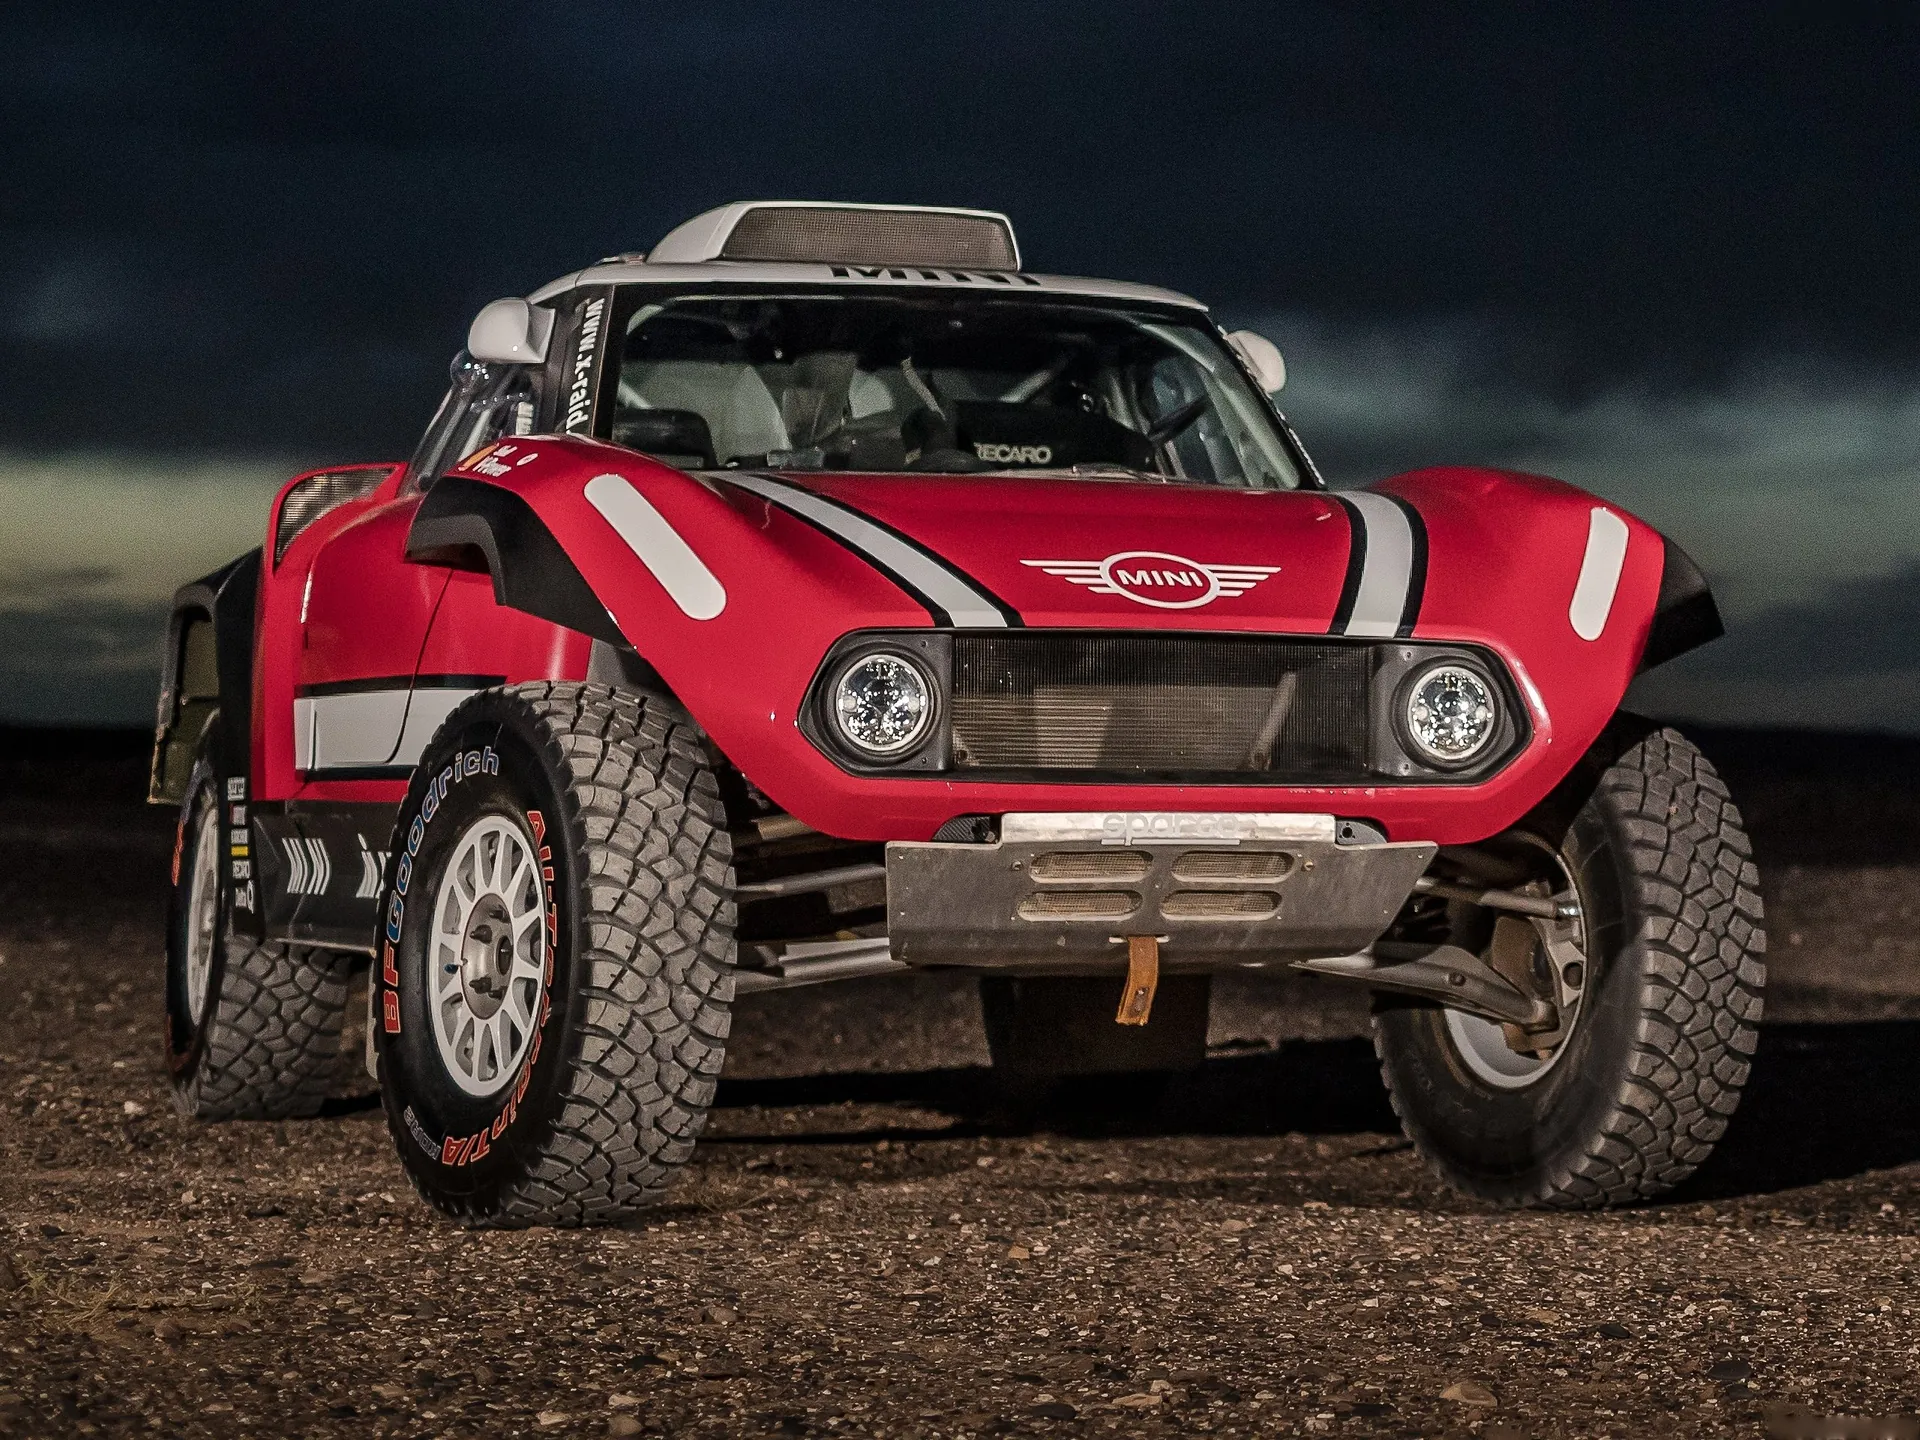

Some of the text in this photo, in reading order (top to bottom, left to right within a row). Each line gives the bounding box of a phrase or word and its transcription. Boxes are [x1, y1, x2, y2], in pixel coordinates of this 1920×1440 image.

[1116, 570, 1203, 587] MINI
[1102, 813, 1239, 846] sparco
[383, 746, 500, 1034] BFGoodrich
[442, 1127, 490, 1166] T/A
